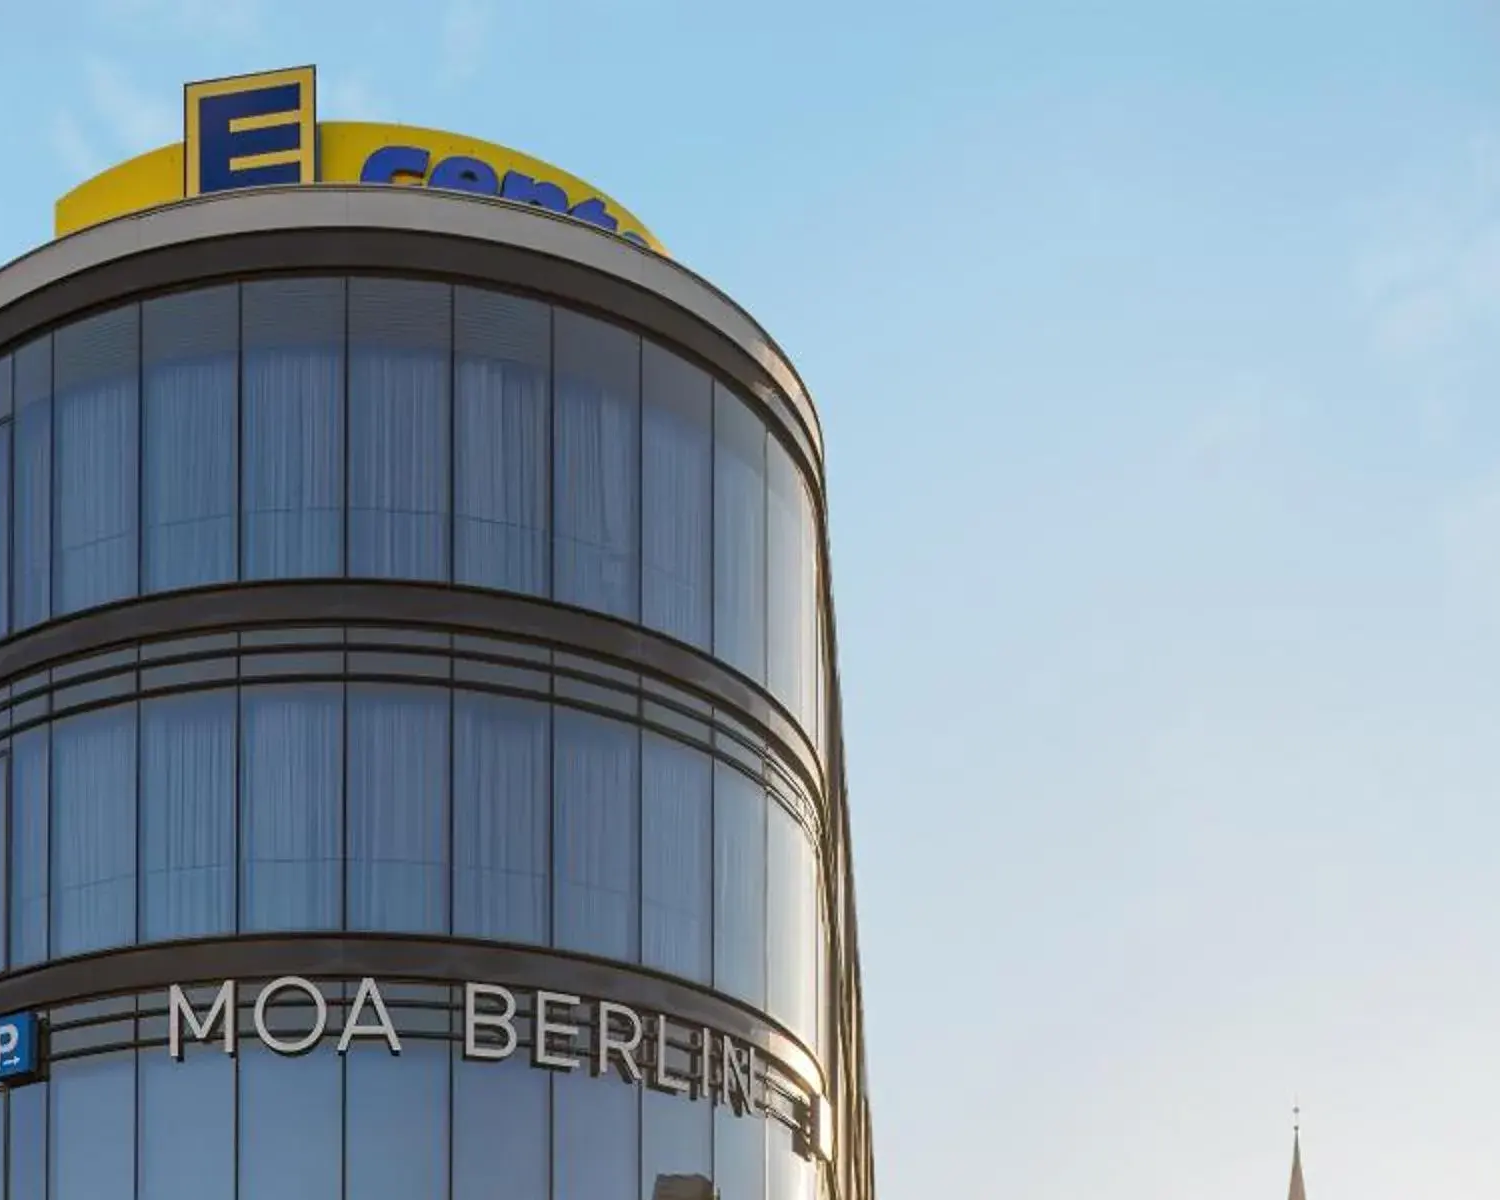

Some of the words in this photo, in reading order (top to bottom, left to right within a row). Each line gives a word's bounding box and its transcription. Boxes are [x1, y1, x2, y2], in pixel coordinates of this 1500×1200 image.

[199, 82, 300, 193] E
[169, 976, 401, 1061] MOA
[465, 981, 757, 1114] BERLIN
